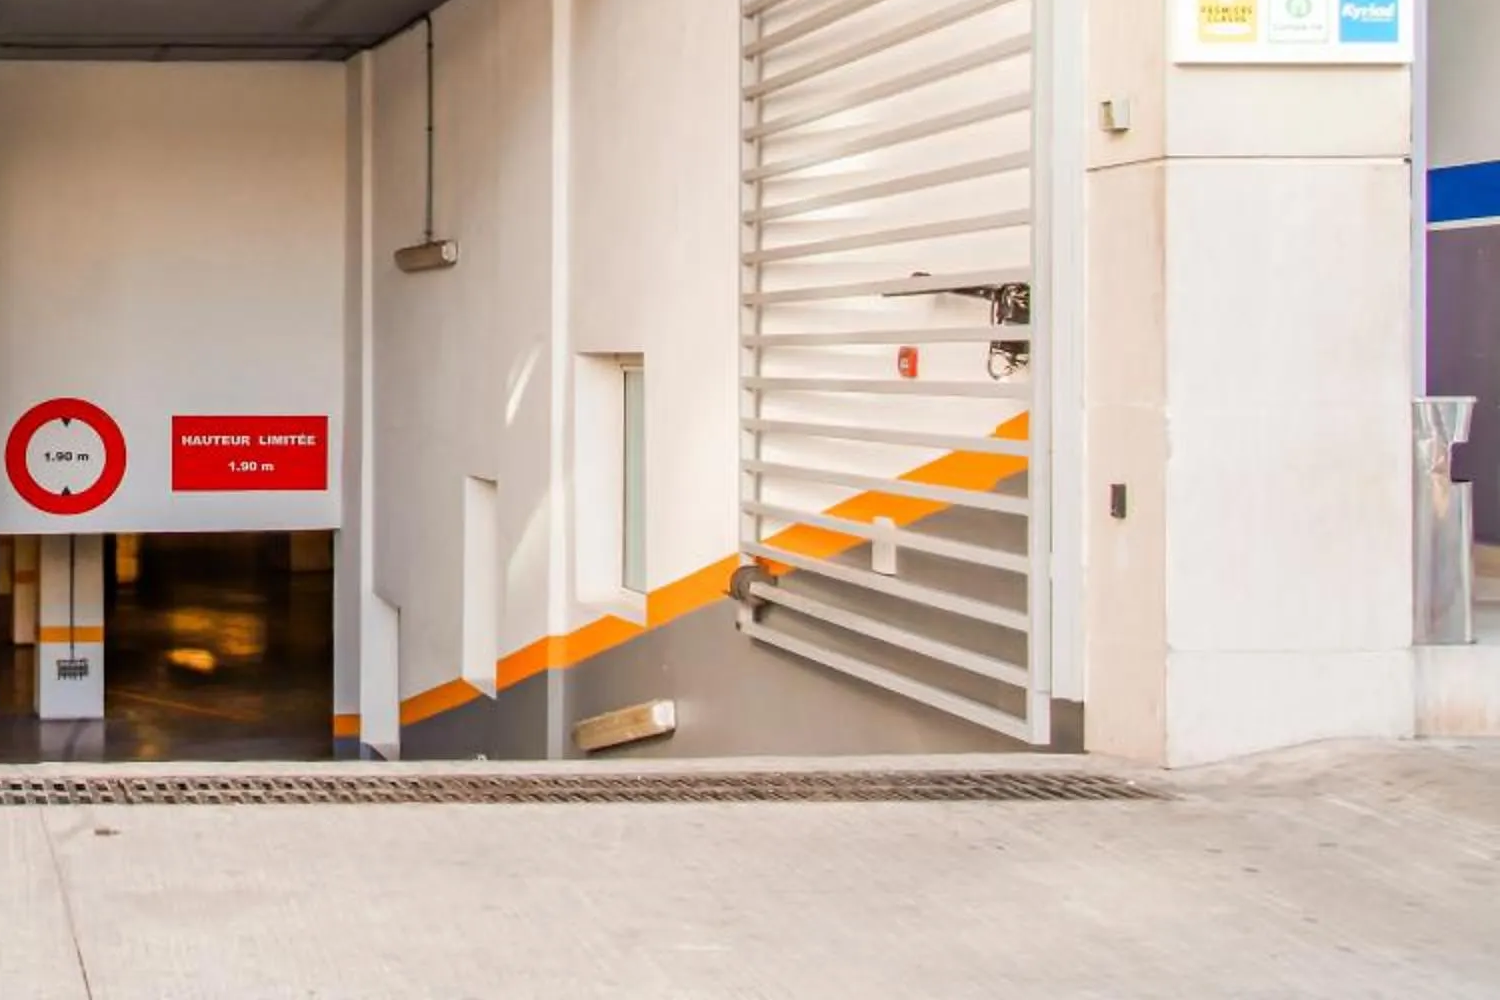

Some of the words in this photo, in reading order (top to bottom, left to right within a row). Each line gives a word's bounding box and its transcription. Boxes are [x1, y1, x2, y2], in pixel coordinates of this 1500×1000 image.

[181, 435, 251, 446] HAUTEUR
[259, 433, 316, 446] LIMITÉE
[44, 451, 73, 462] 1.90
[77, 453, 89, 461] m
[227, 461, 257, 472] 1.90
[261, 463, 274, 471] m
